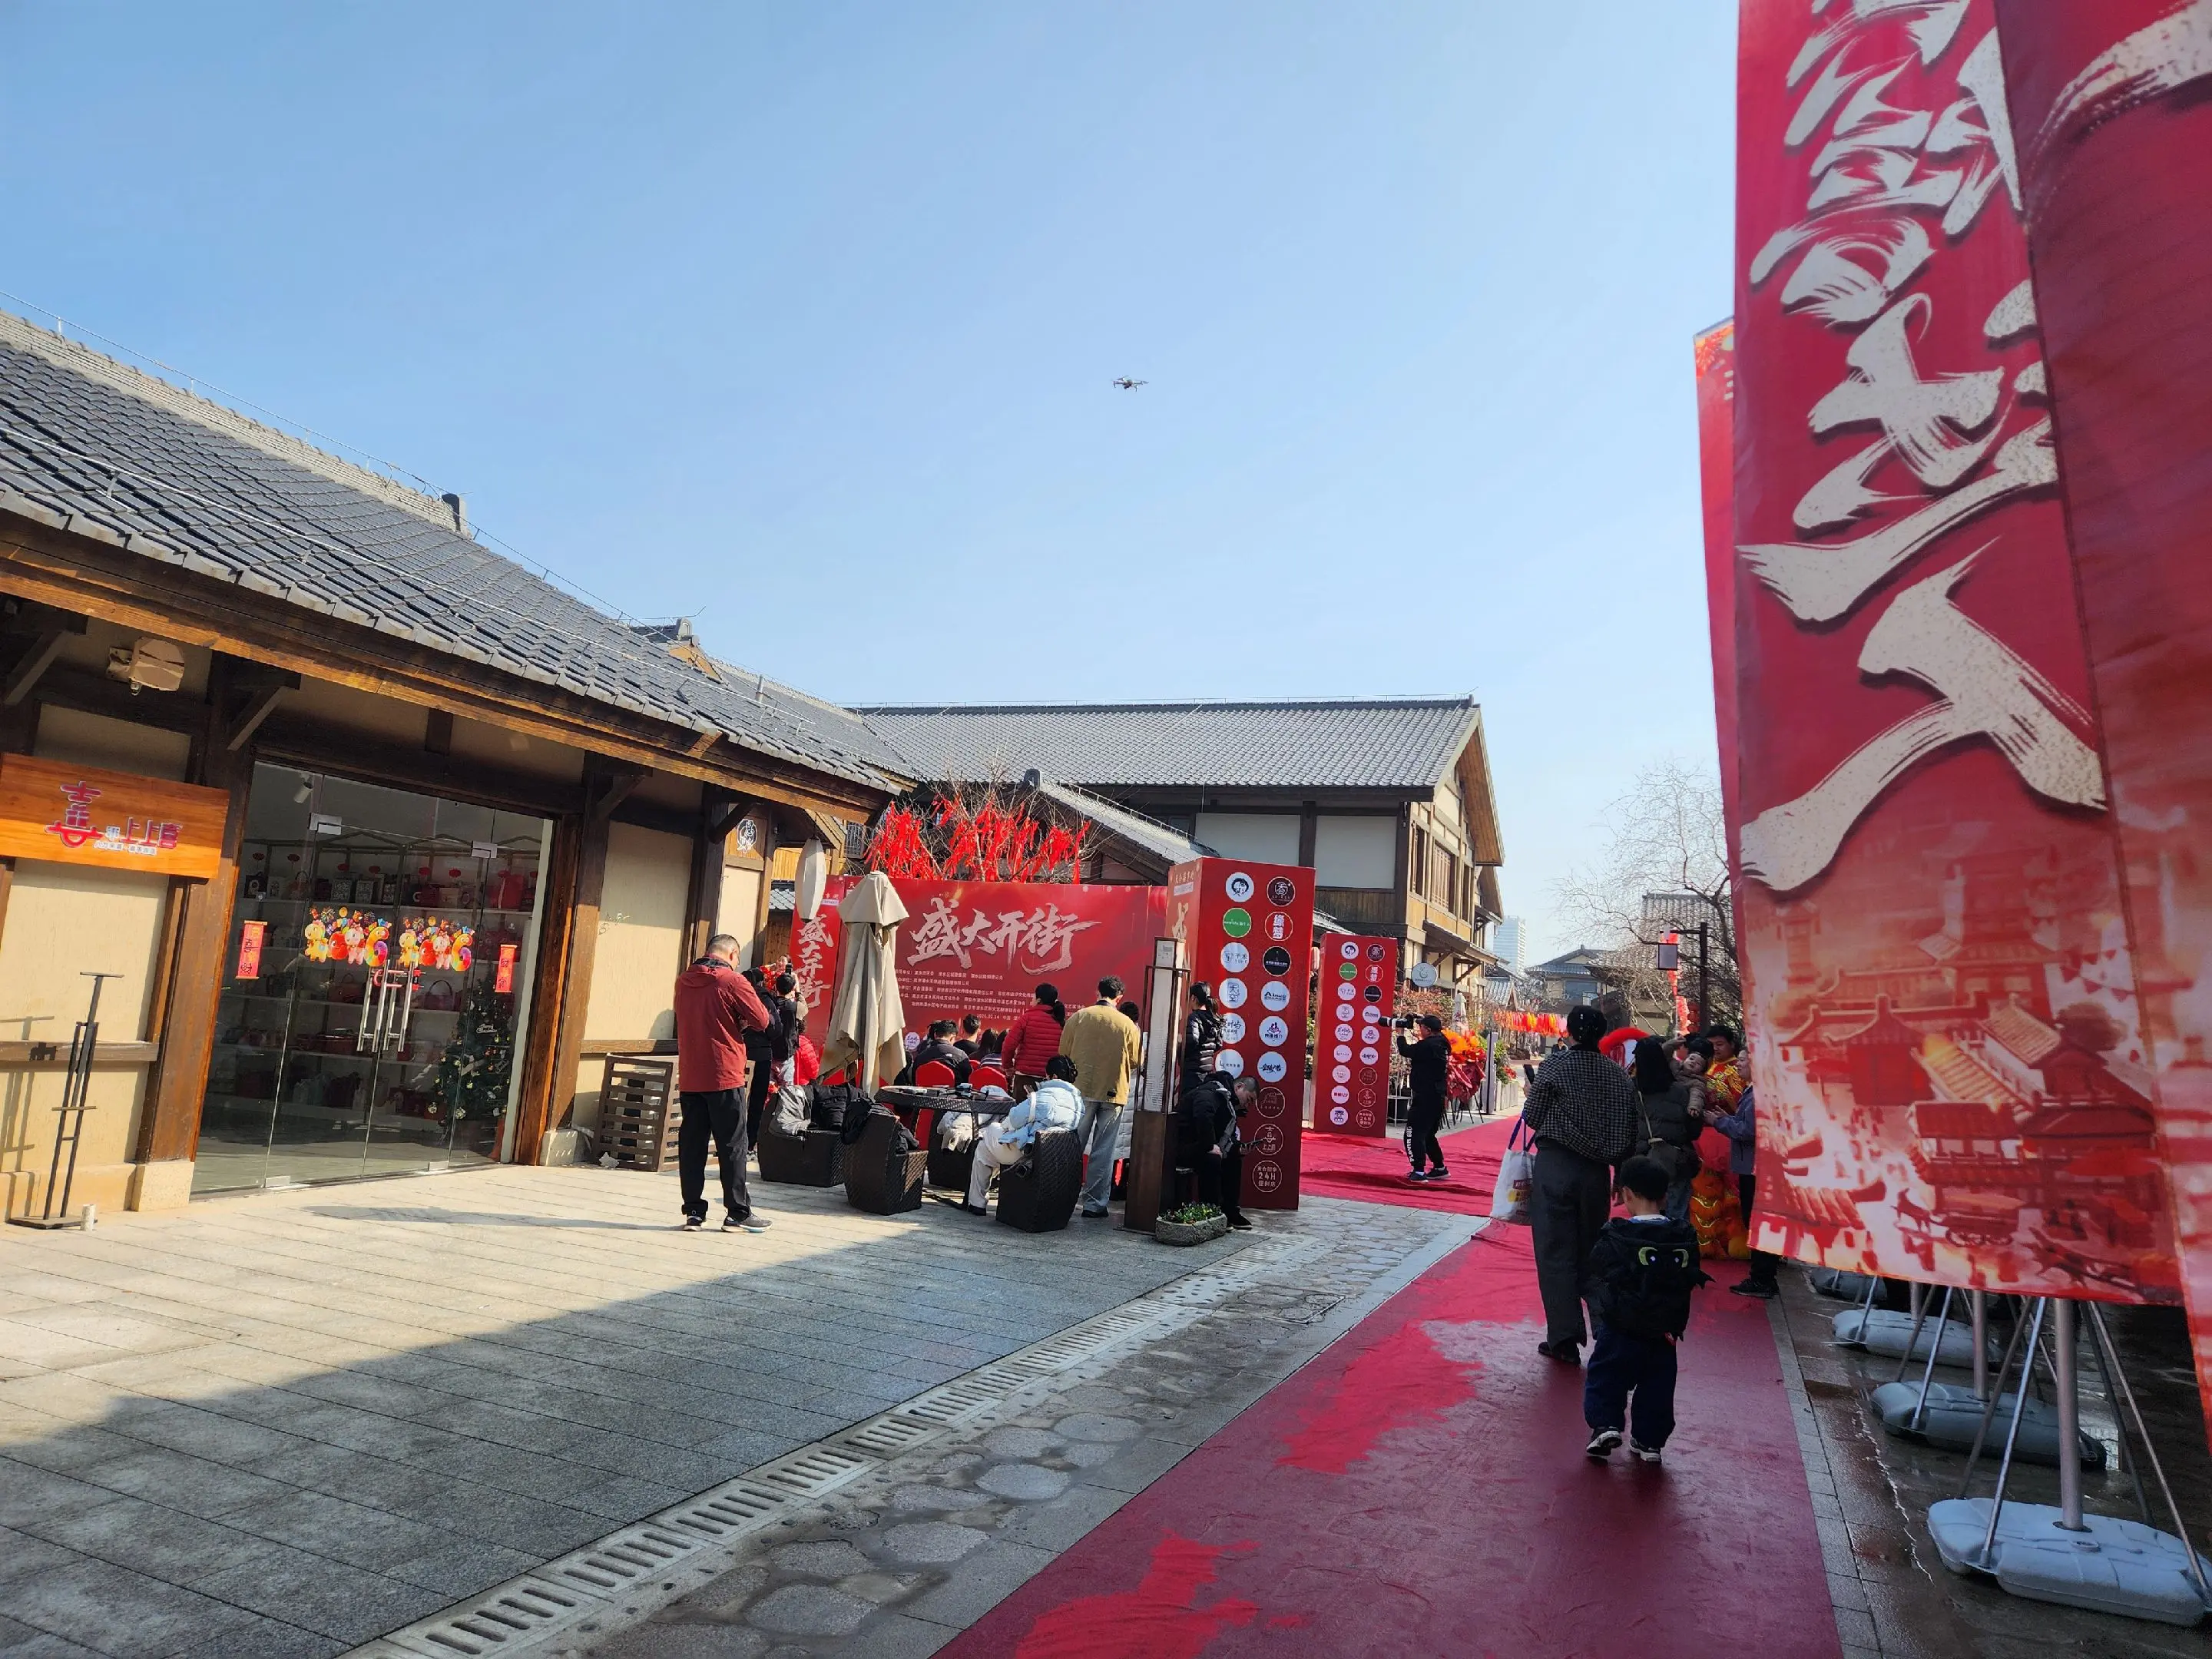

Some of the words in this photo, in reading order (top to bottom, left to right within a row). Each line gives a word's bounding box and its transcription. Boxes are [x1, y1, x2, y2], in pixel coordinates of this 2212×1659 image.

[796, 913, 834, 1008] 盛大开街
[907, 897, 1102, 975] 盛大开街
[1258, 1172, 1276, 1181] 24H
